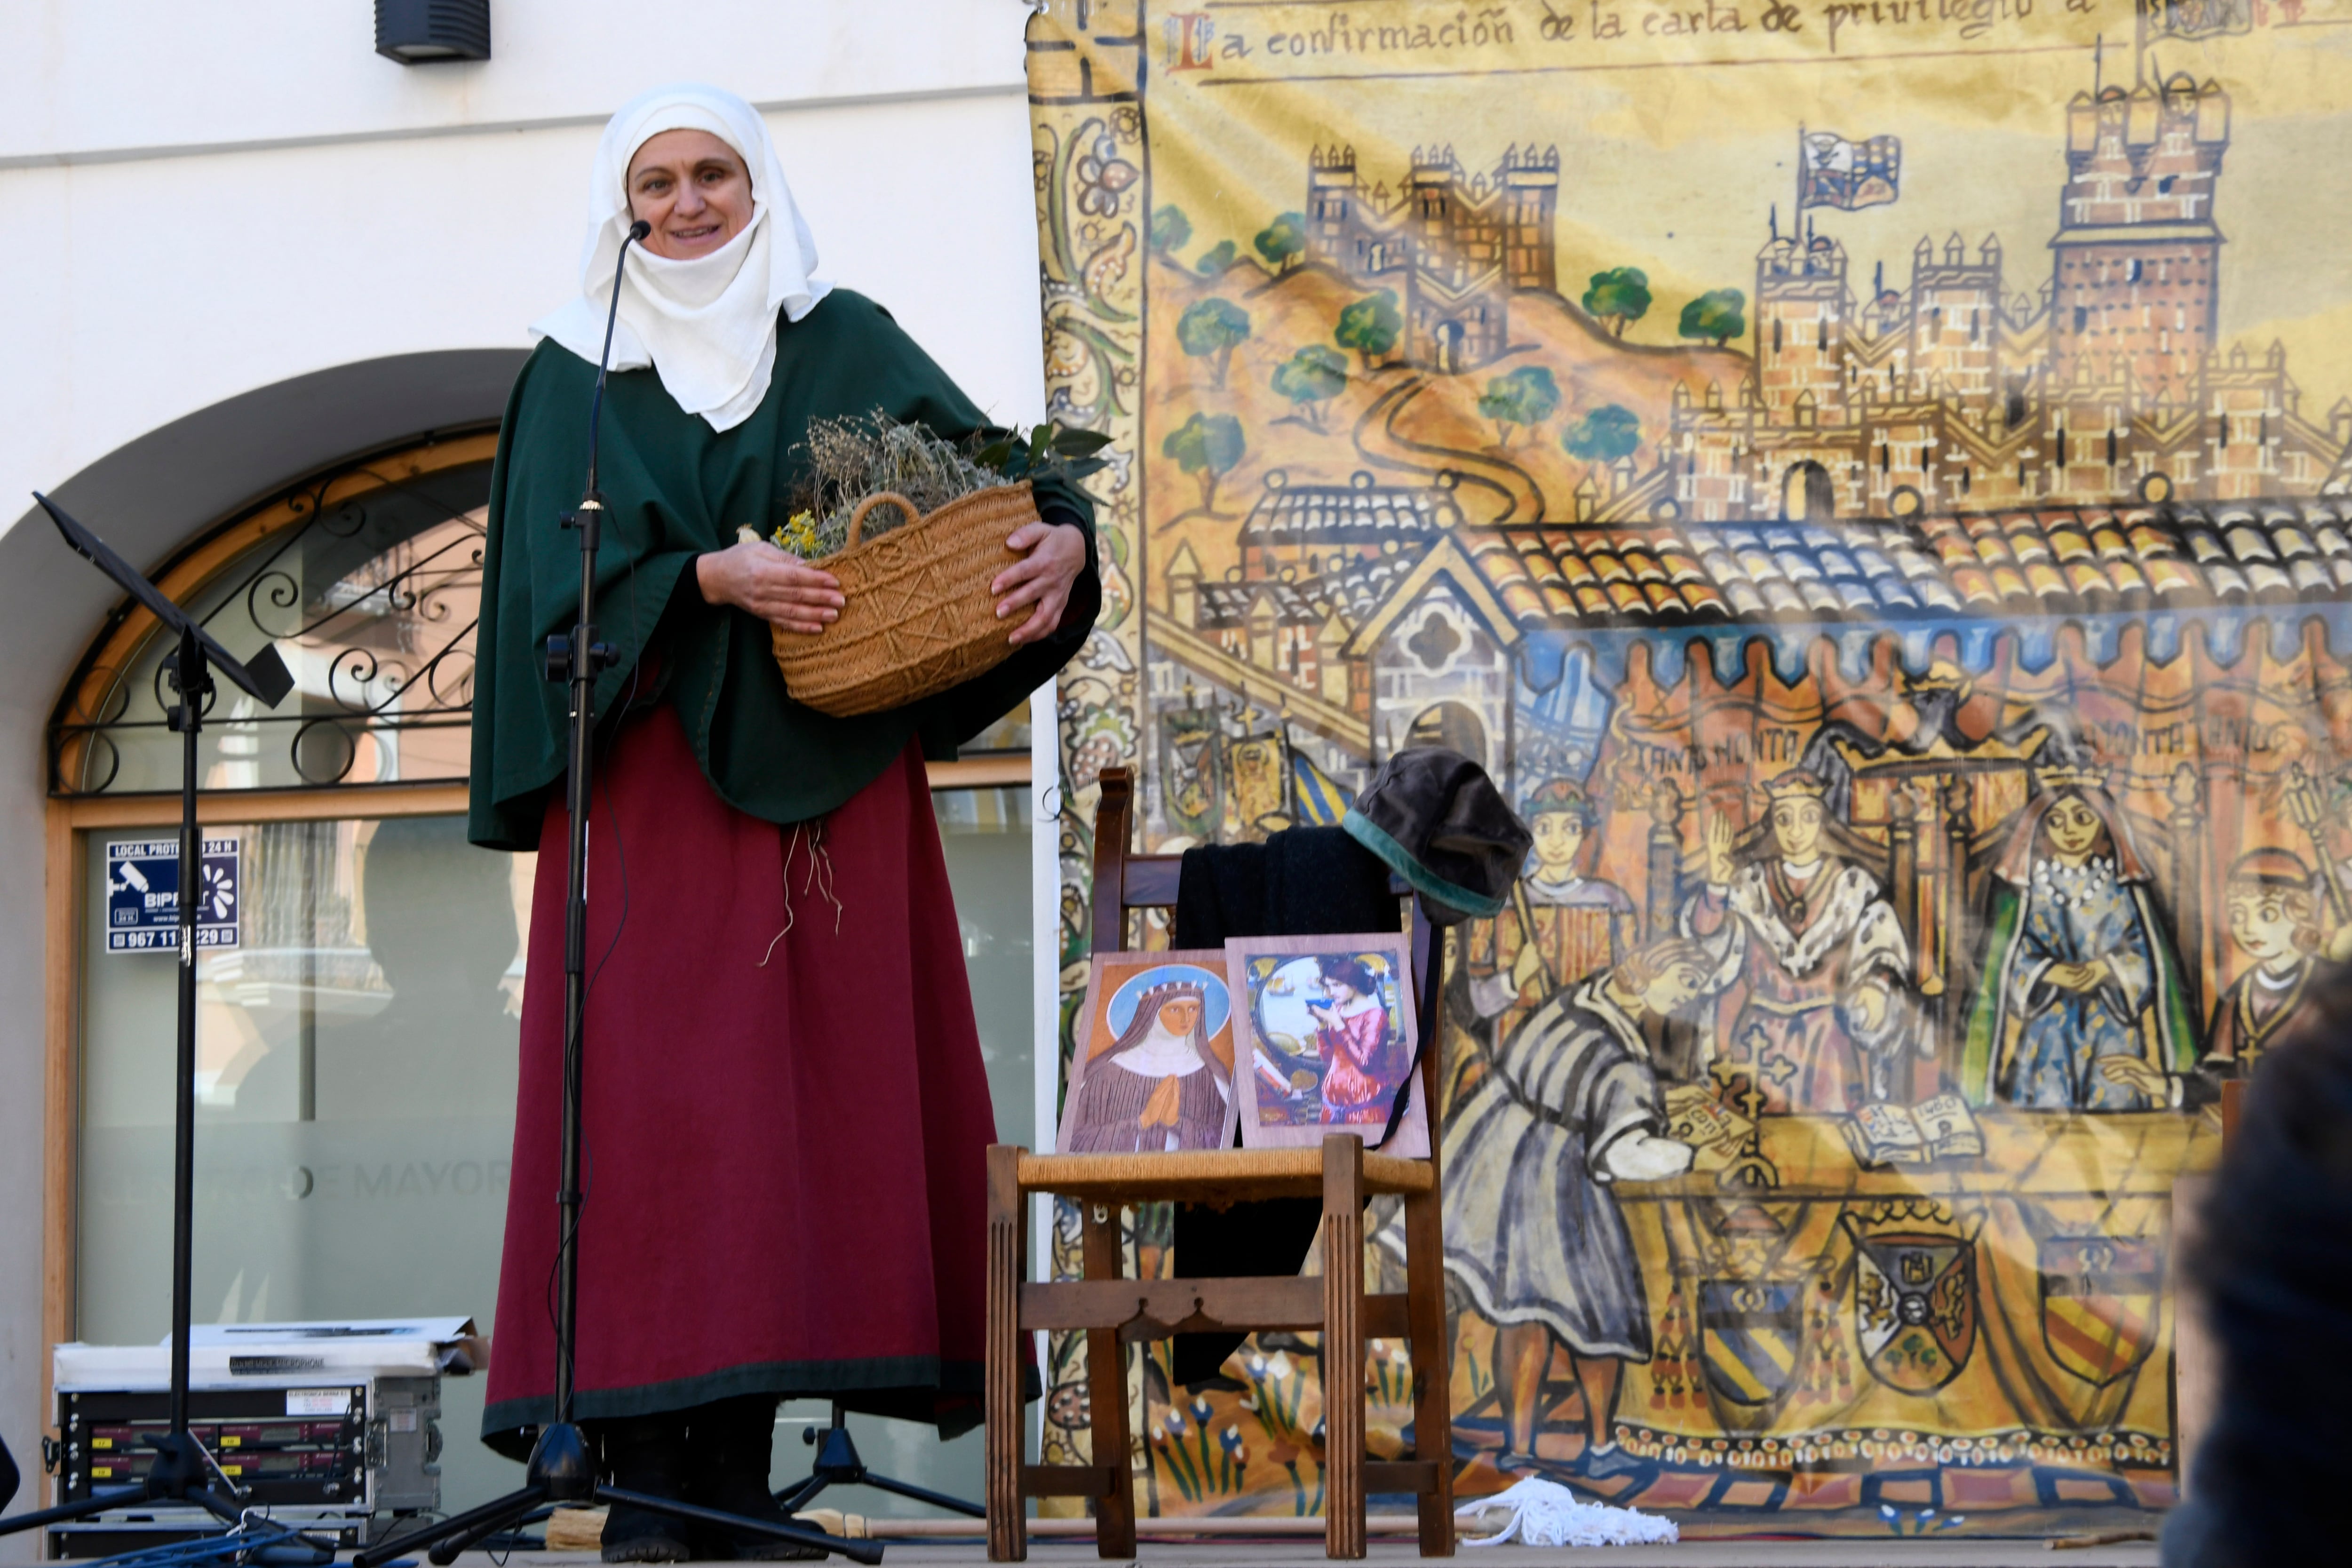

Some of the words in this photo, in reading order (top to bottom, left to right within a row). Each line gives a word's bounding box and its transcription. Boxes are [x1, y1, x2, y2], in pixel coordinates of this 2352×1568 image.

[1166, 11, 1253, 75] La
[1540, 0, 1574, 40] de
[1592, 0, 1627, 39] la
[1642, 0, 1748, 35] carta
[1760, 0, 1802, 32] de
[115, 845, 147, 857] LOCAL
[208, 841, 221, 853] 24
[224, 840, 232, 852] H
[128, 931, 155, 947] 967
